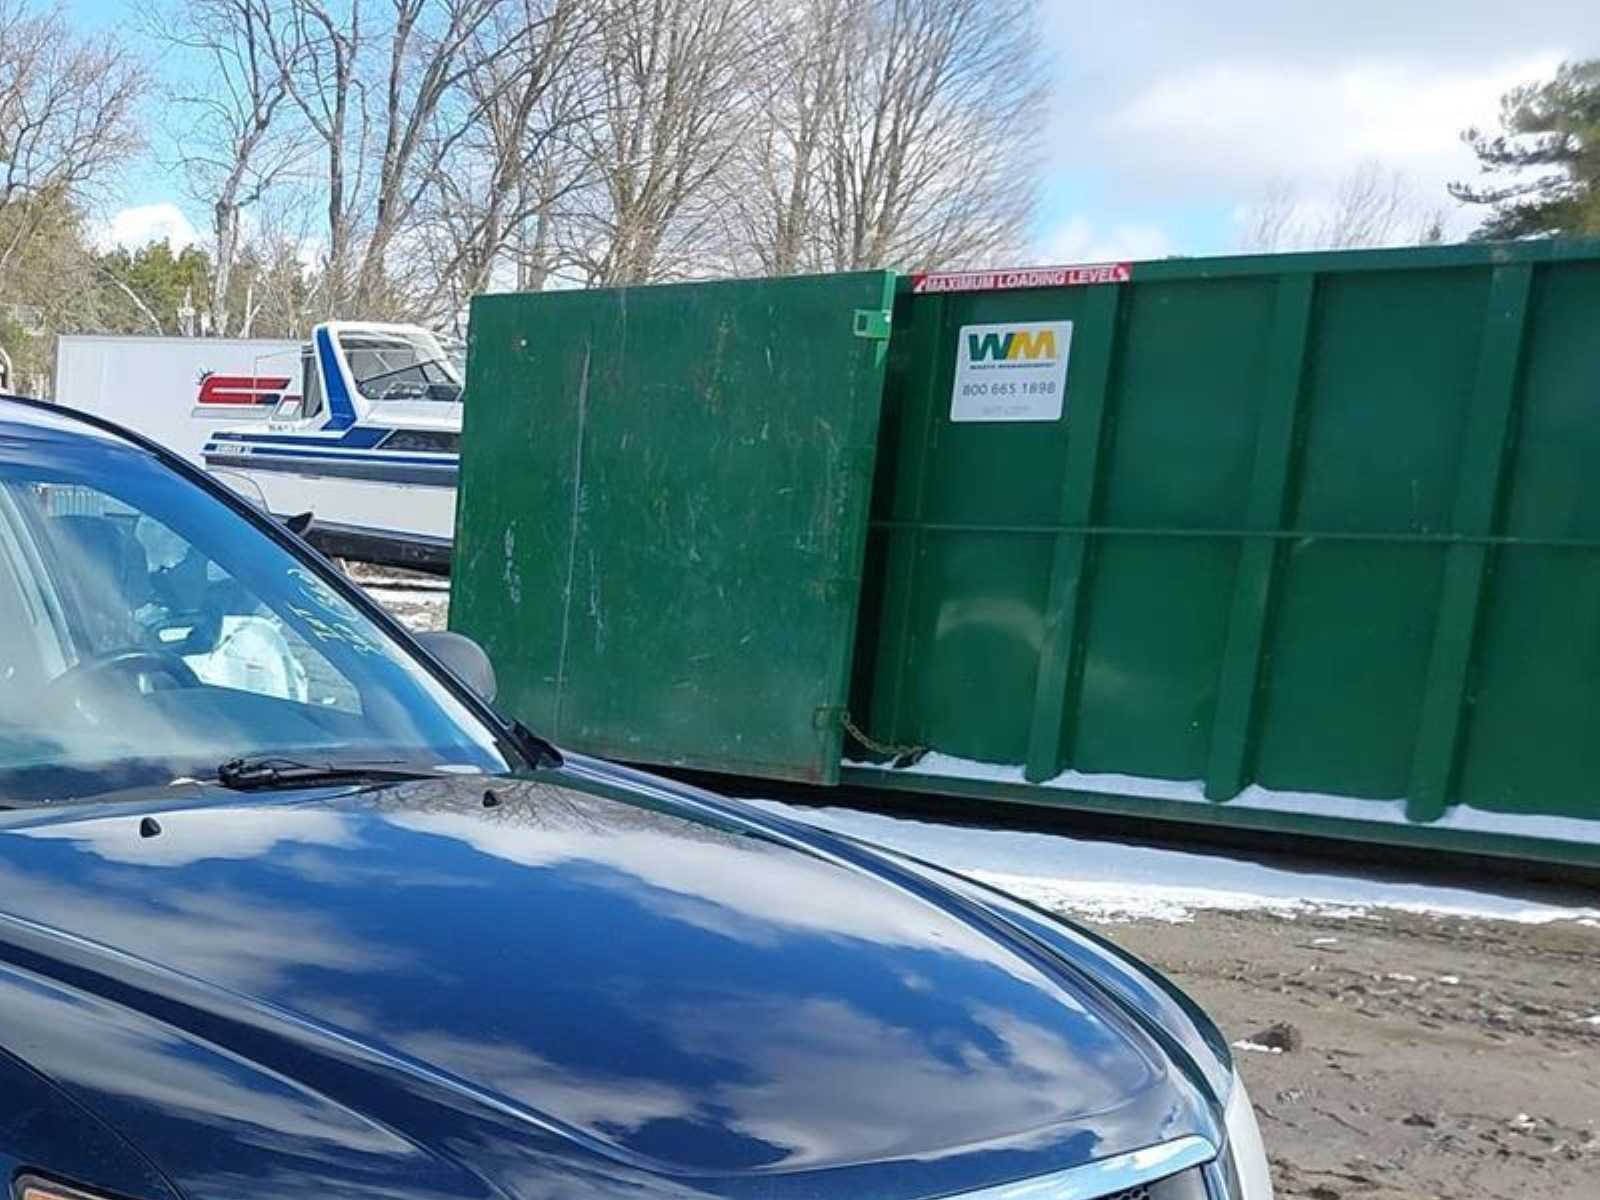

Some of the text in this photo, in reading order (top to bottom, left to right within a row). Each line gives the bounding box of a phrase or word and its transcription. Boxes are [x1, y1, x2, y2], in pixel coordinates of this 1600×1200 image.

[928, 267, 1116, 291] MAXIMUM LOADING LEVEL
[967, 330, 1057, 362] WM
[962, 383, 988, 396] 800
[991, 383, 1016, 395] 665
